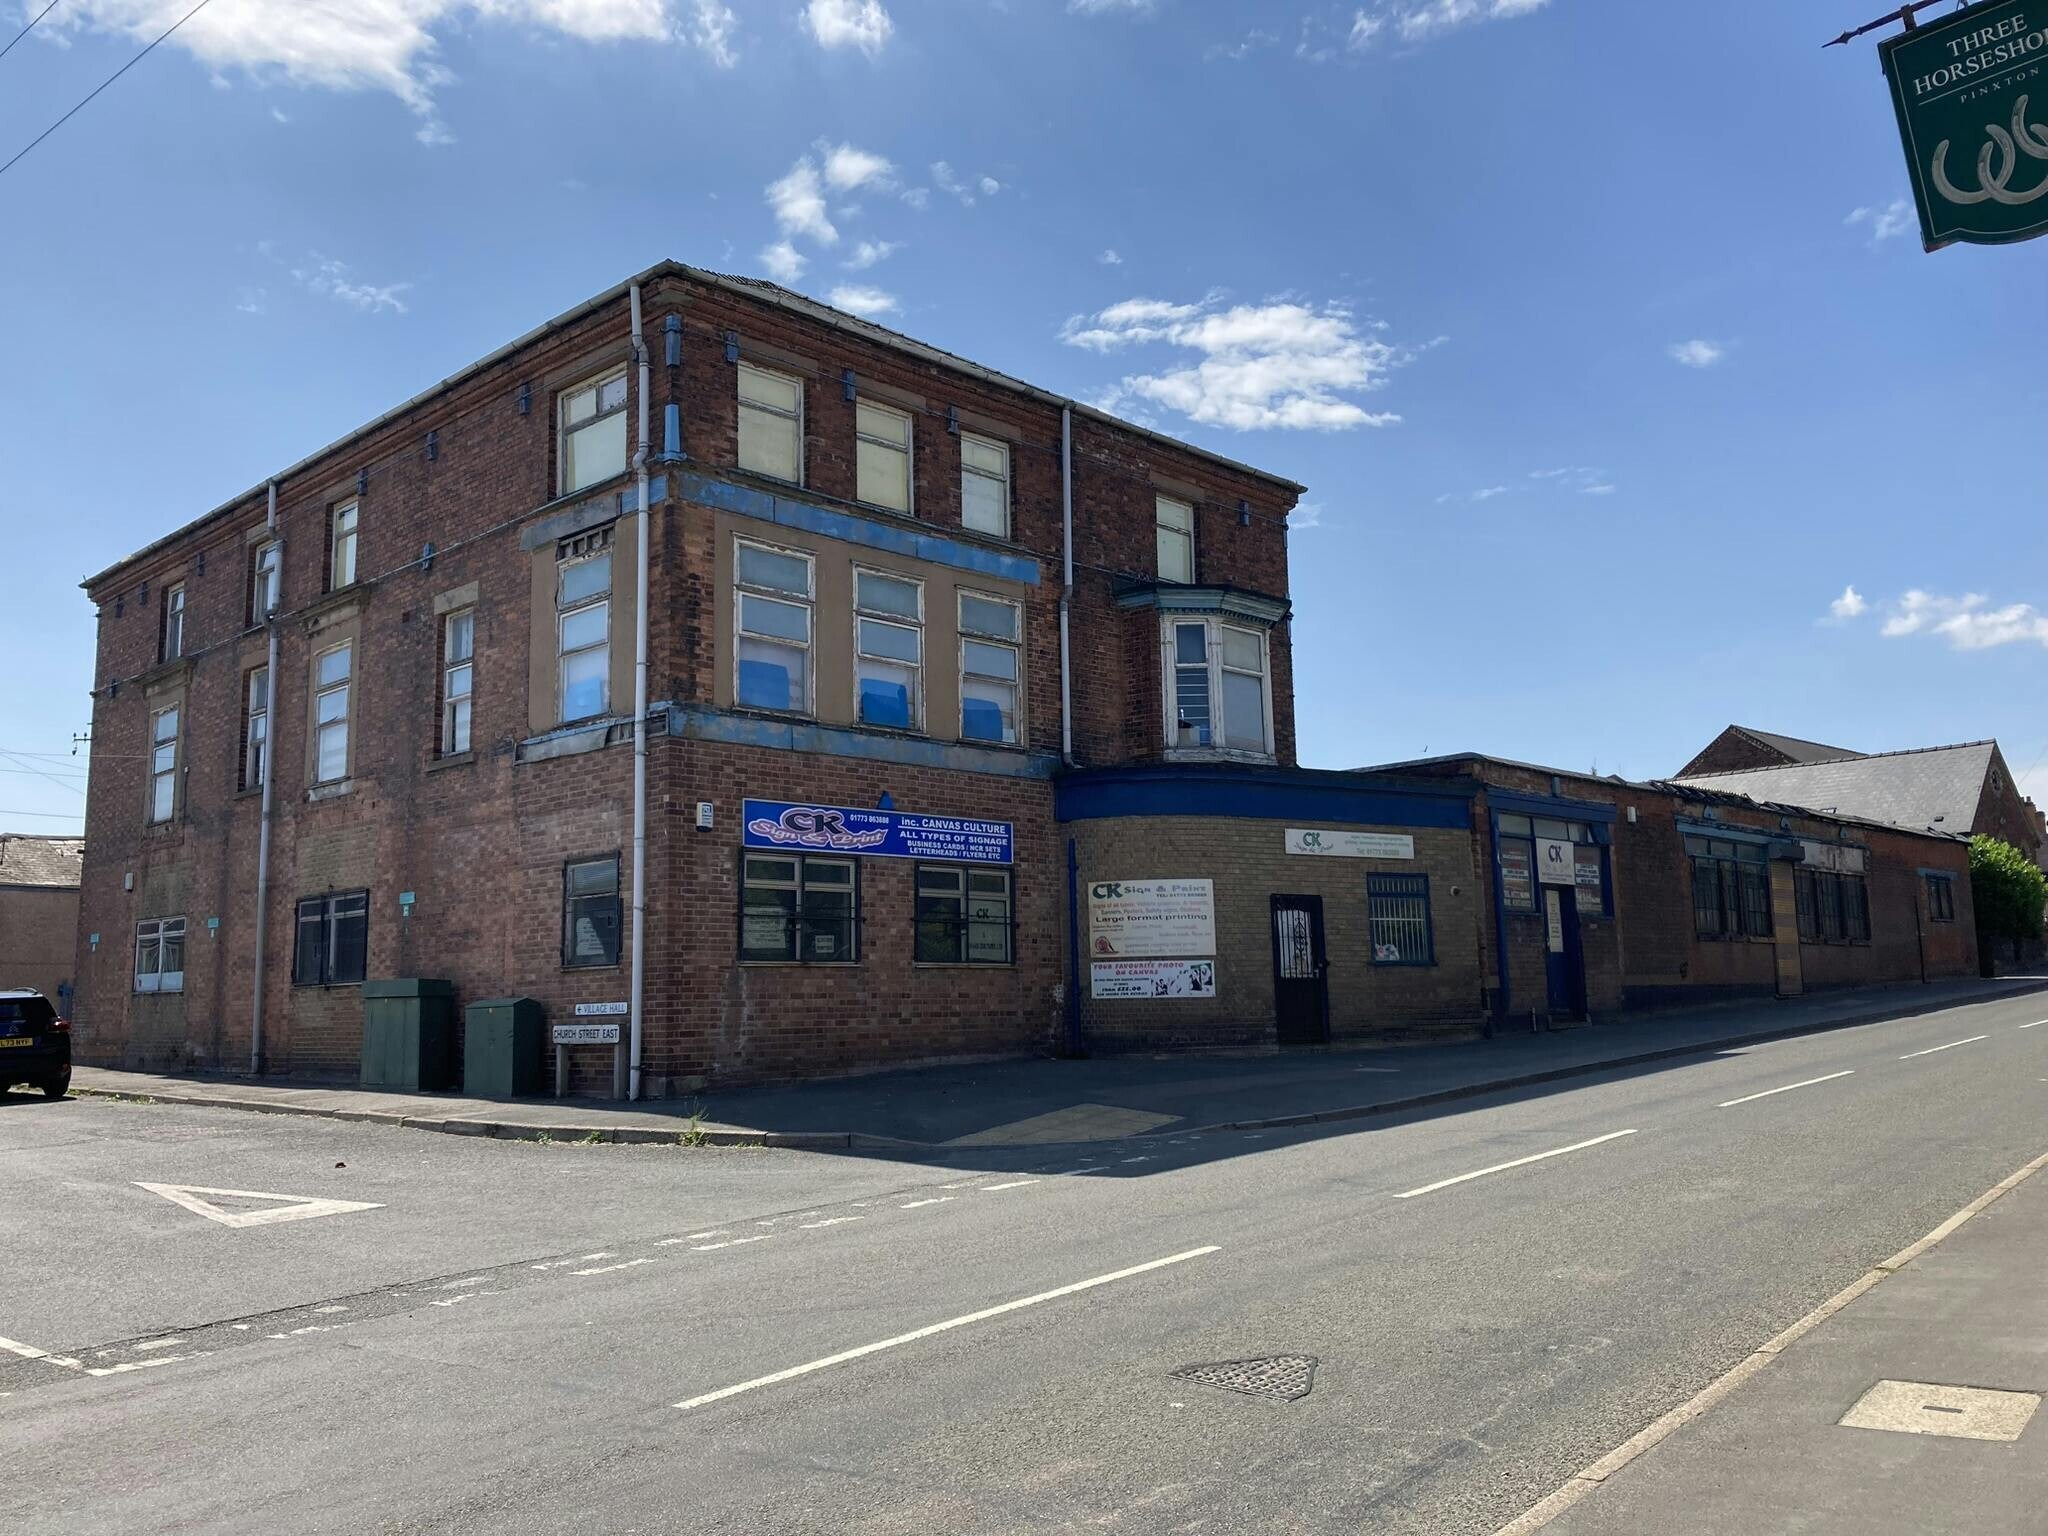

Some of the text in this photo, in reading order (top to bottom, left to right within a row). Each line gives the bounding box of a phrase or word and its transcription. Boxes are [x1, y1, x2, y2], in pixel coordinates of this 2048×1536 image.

[1946, 14, 2028, 57] THREE
[1960, 67, 2040, 103] PINXTON
[784, 812, 843, 835] CK
[922, 818, 961, 830] CANVAS
[963, 822, 1006, 834] CULTURE
[752, 822, 798, 839] Sign
[832, 832, 883, 845] Print
[899, 830, 918, 839] ALL
[920, 831, 951, 841] TYPES
[968, 836, 1008, 846] SIGNAGE
[1303, 831, 1322, 847] CK
[907, 840, 941, 849] BUSINESS
[942, 842, 965, 850] CARDS
[970, 844, 984, 852] NCR
[985, 845, 1001, 853] SETS
[909, 847, 958, 857] LETTERHEADS
[988, 852, 1001, 860] ETC
[1548, 844, 1563, 863] CK
[1092, 882, 1124, 900] CK
[1124, 886, 1151, 895] Sign
[1165, 913, 1207, 921] printing
[583, 1003, 625, 1014] VILLAGE HALL
[554, 1029, 618, 1039] CHURCH STREET EAST
